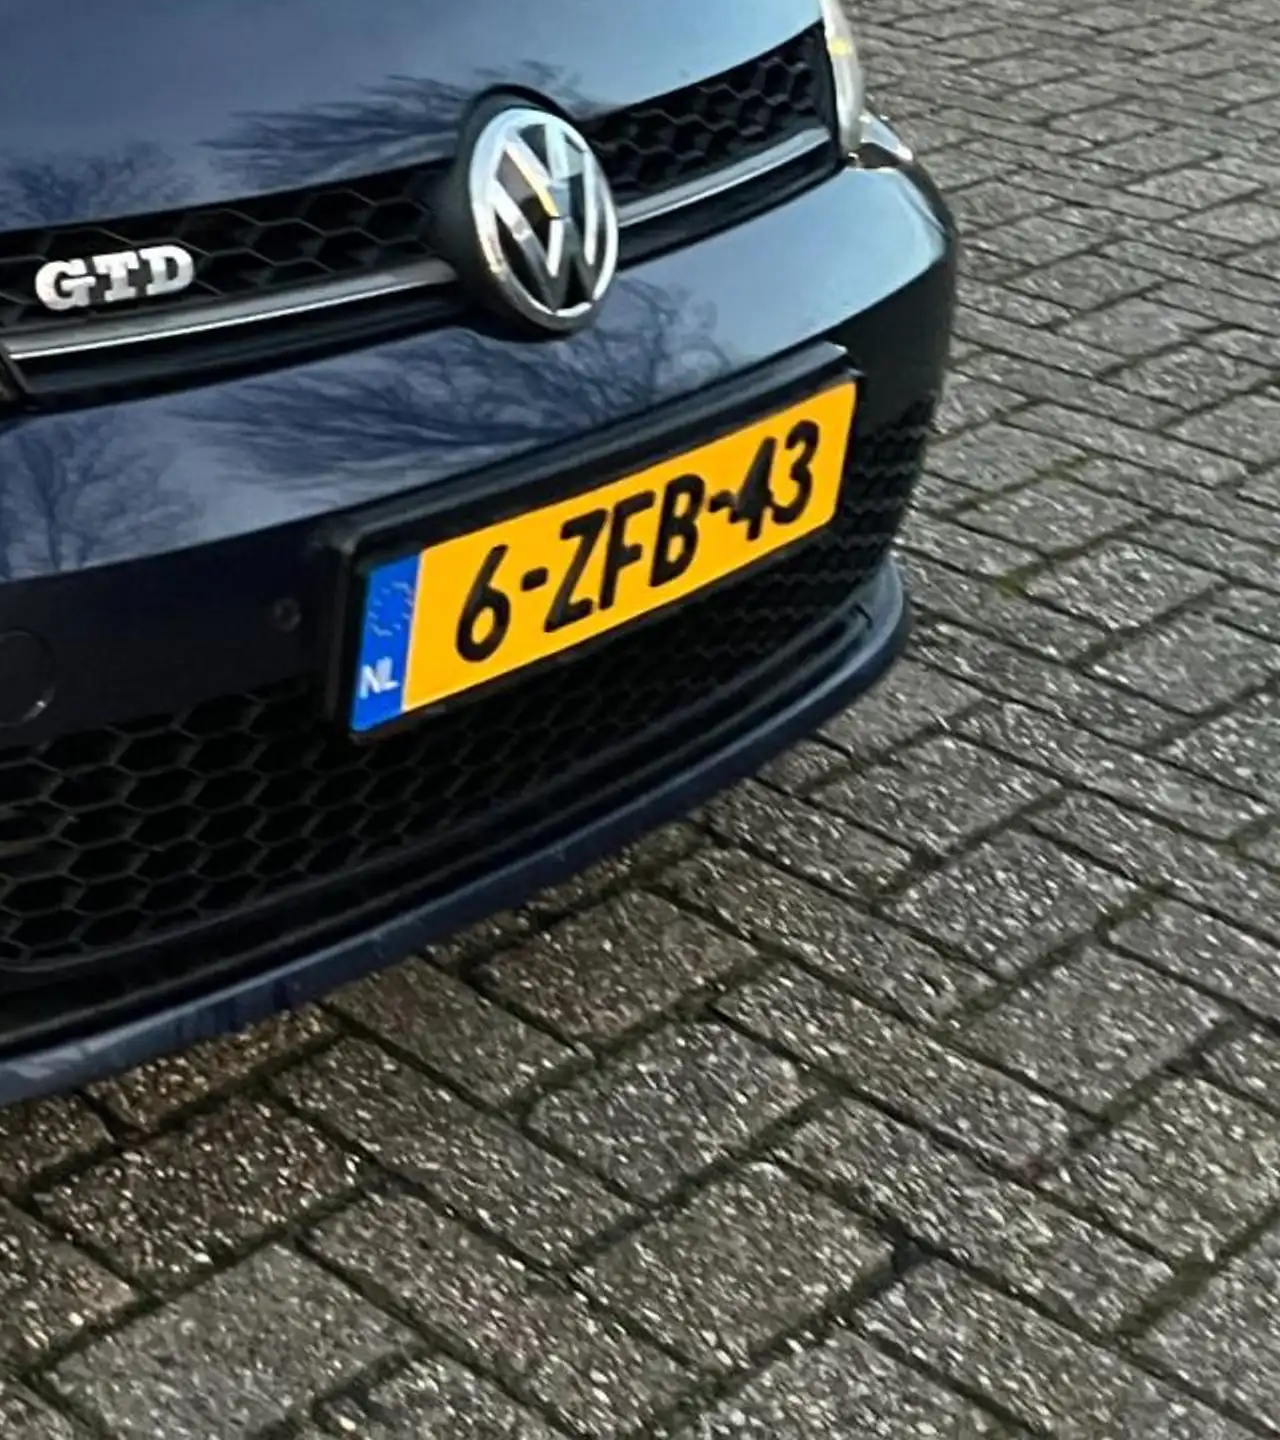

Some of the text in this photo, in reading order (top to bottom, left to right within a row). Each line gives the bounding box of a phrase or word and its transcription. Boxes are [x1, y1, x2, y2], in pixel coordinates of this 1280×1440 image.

[34, 243, 196, 312] GTD
[454, 418, 821, 664] 6-ZFB-43
[359, 656, 400, 700] NL
